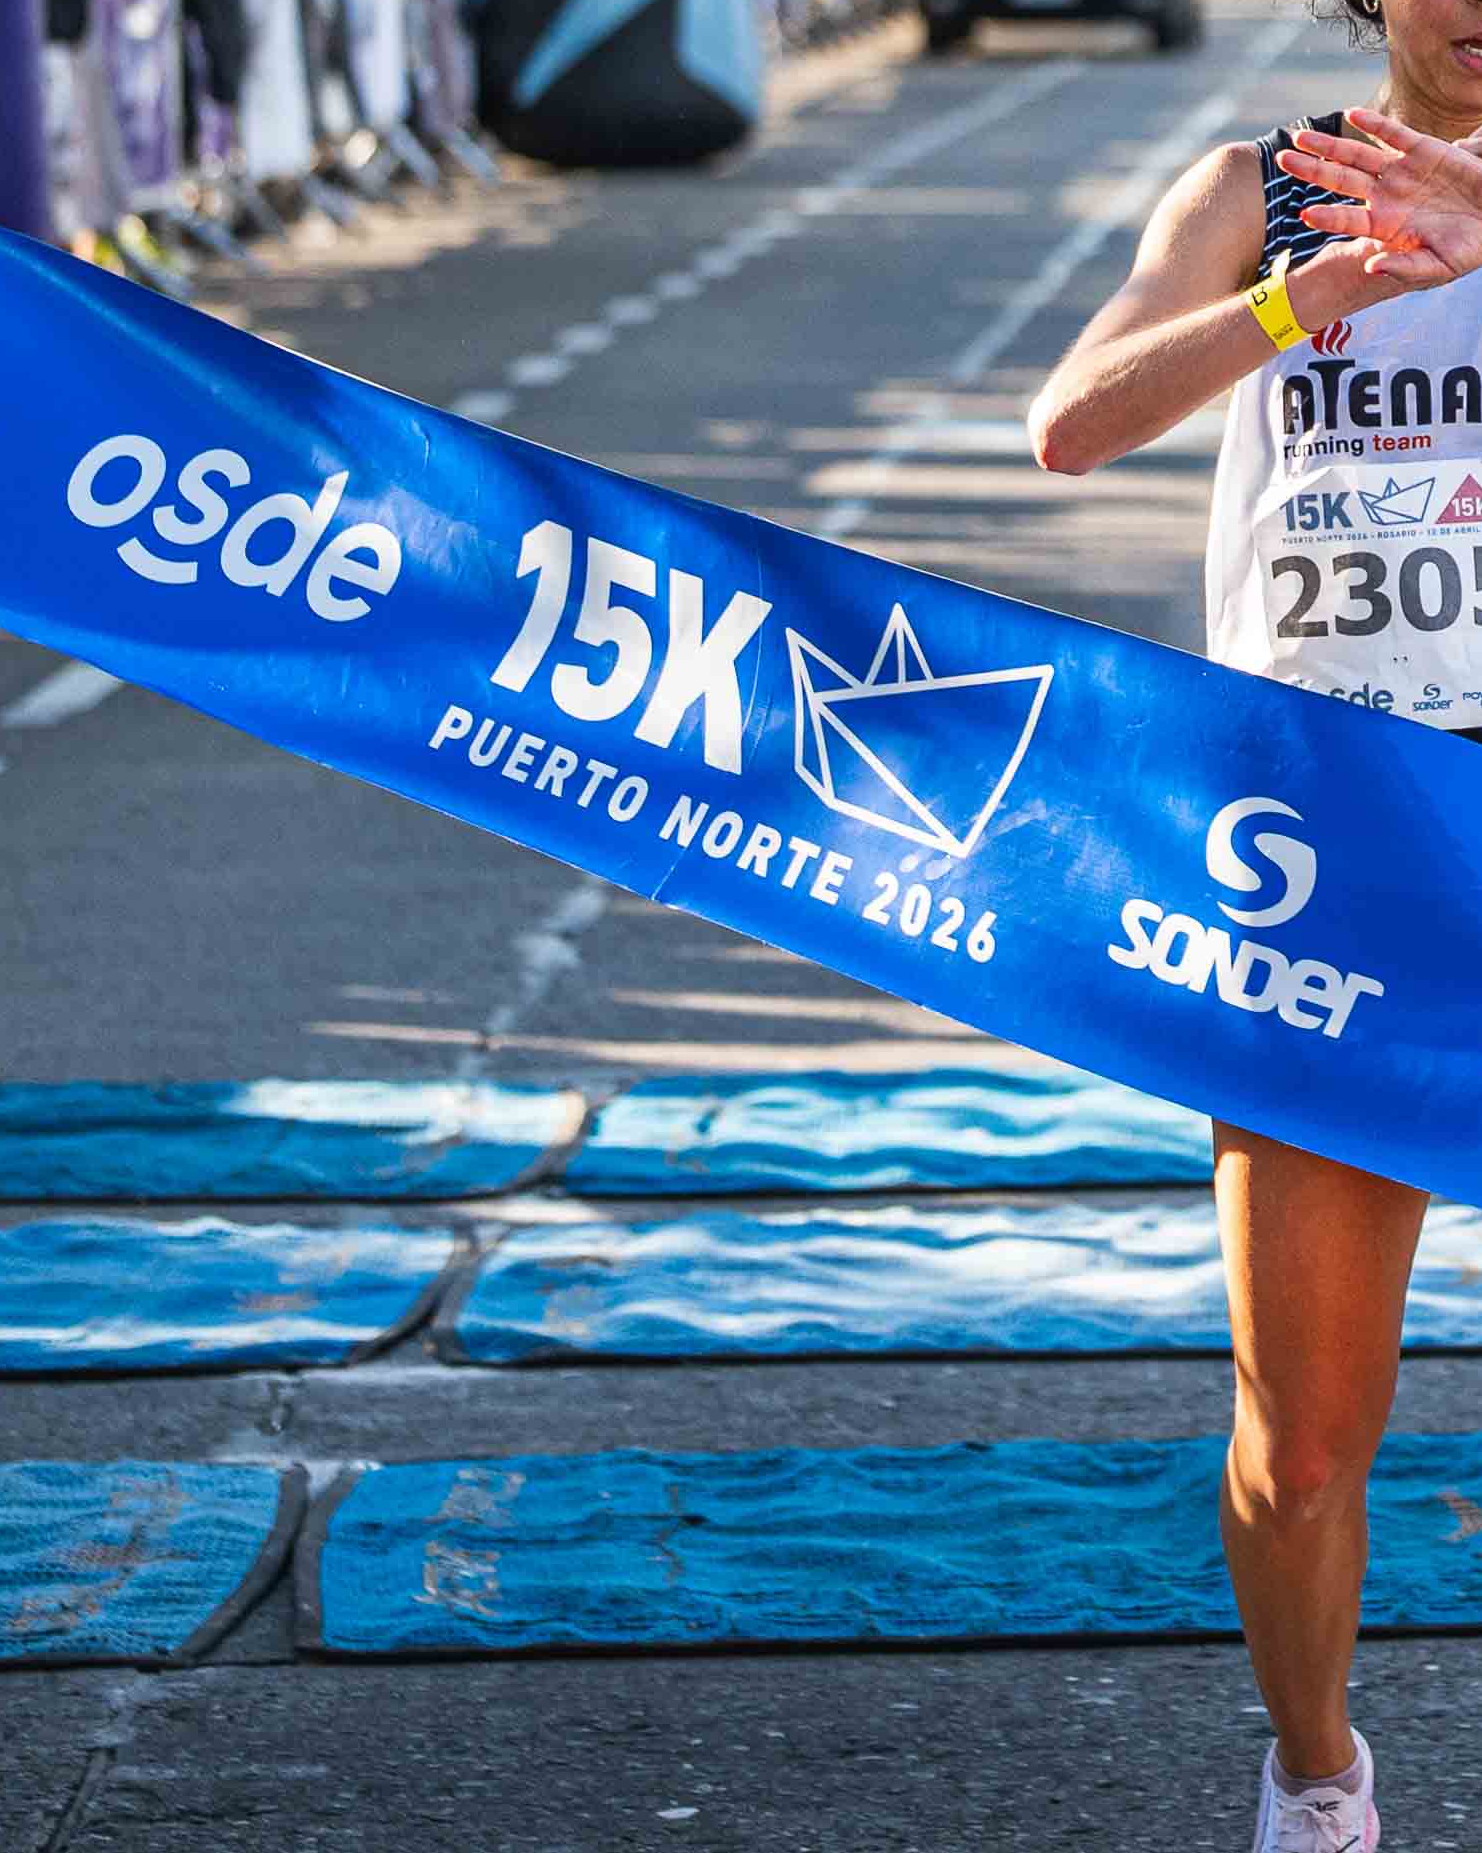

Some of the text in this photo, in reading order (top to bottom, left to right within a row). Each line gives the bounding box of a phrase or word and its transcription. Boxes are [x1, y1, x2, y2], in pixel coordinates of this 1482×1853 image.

[66, 433, 403, 622] osde
[1279, 491, 1353, 532] 15K
[1283, 434, 1432, 460] running team
[489, 519, 774, 776] 15K
[427, 703, 998, 964] PUERTO NORTE 2026
